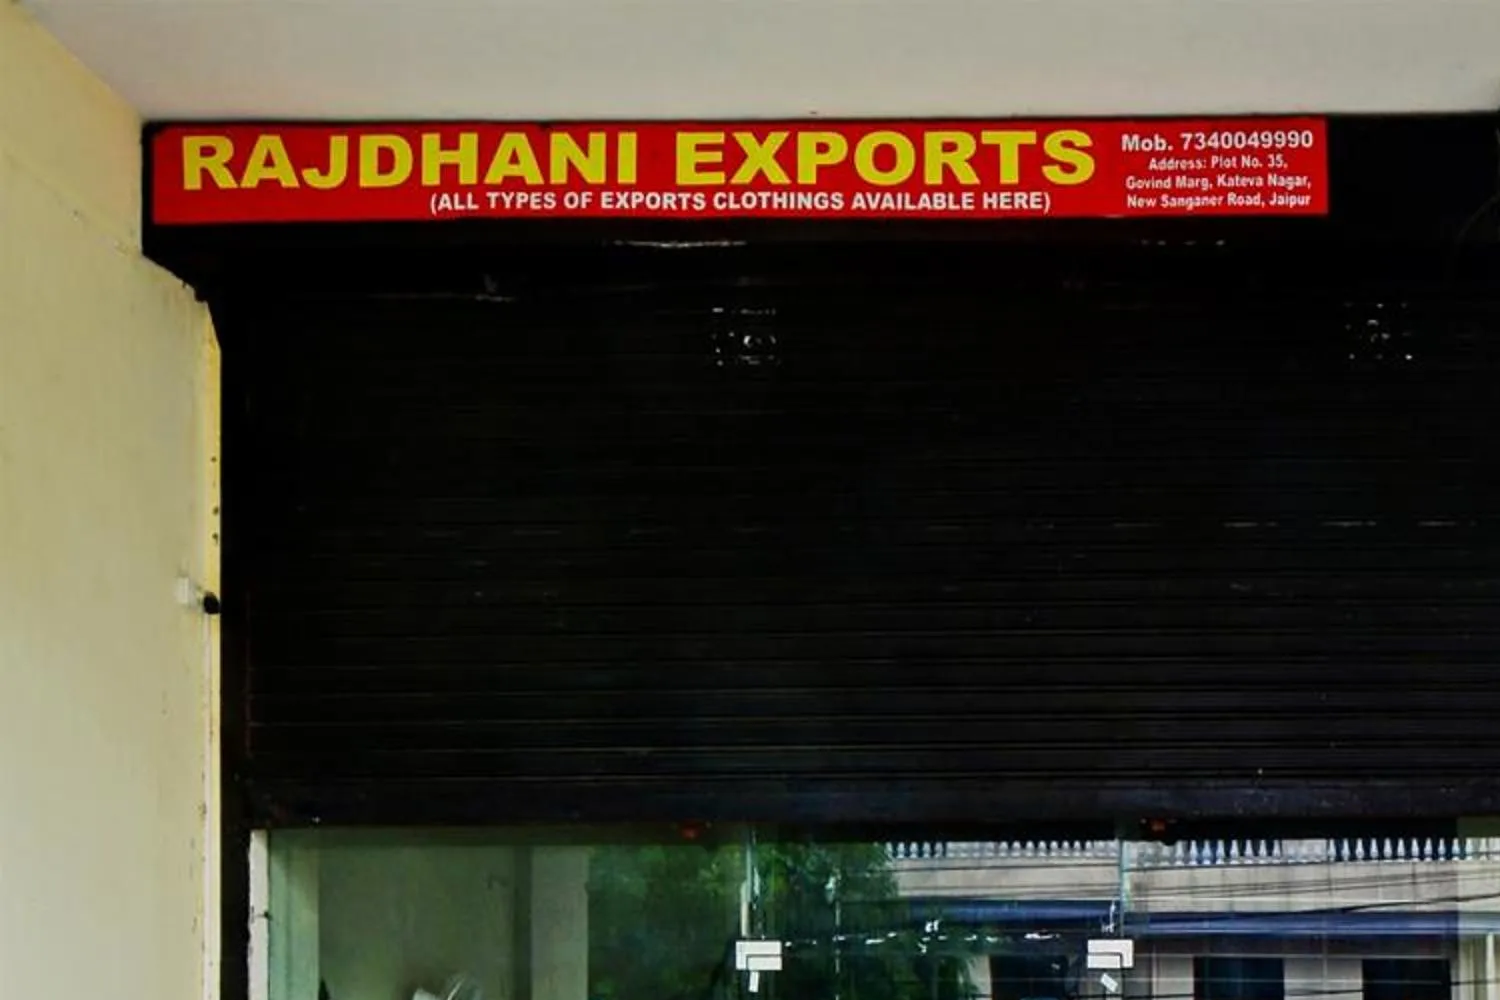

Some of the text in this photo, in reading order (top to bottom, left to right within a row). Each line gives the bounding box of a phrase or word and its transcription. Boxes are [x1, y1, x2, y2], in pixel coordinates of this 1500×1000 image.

[1121, 130, 1313, 152] Mob. 7340049990
[181, 130, 1096, 190] RAJDHANI EXPORTS
[1149, 156, 1206, 171] Address:
[1211, 154, 1237, 169] Plot
[1241, 154, 1263, 169] No.
[1125, 174, 1172, 190] Govind
[1175, 174, 1213, 191] Marg,
[1267, 173, 1311, 190] Nagar,
[429, 191, 1051, 215] (ALL TYPES OF EXPORTS CLOTHINGS AVAILABLE HERE)
[1127, 192, 1311, 211] New Sanganer Road, Jaipur
